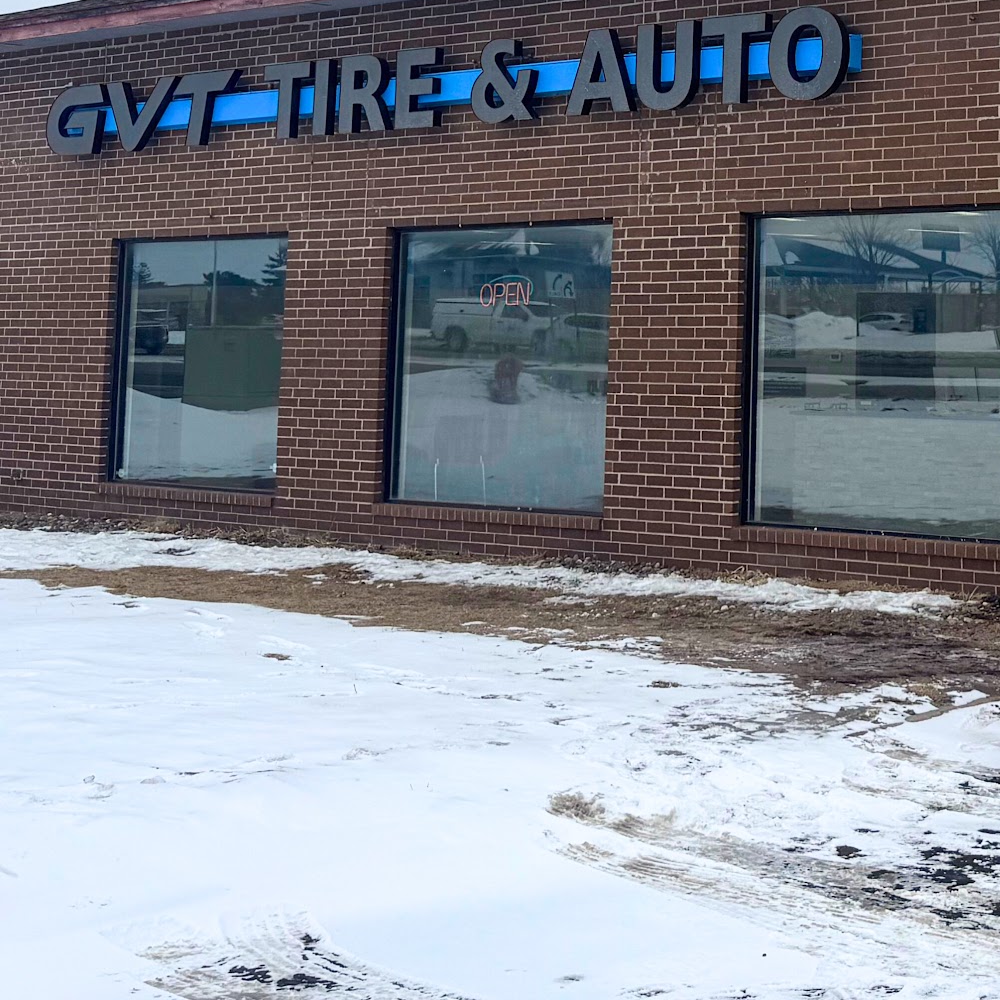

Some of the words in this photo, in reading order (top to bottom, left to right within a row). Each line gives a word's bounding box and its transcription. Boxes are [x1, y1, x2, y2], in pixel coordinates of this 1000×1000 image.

[46, 68, 243, 156] GVT
[264, 47, 443, 140] TIRE
[471, 38, 540, 125] &
[565, 5, 850, 117] AUTO
[480, 282, 530, 307] OPEN
